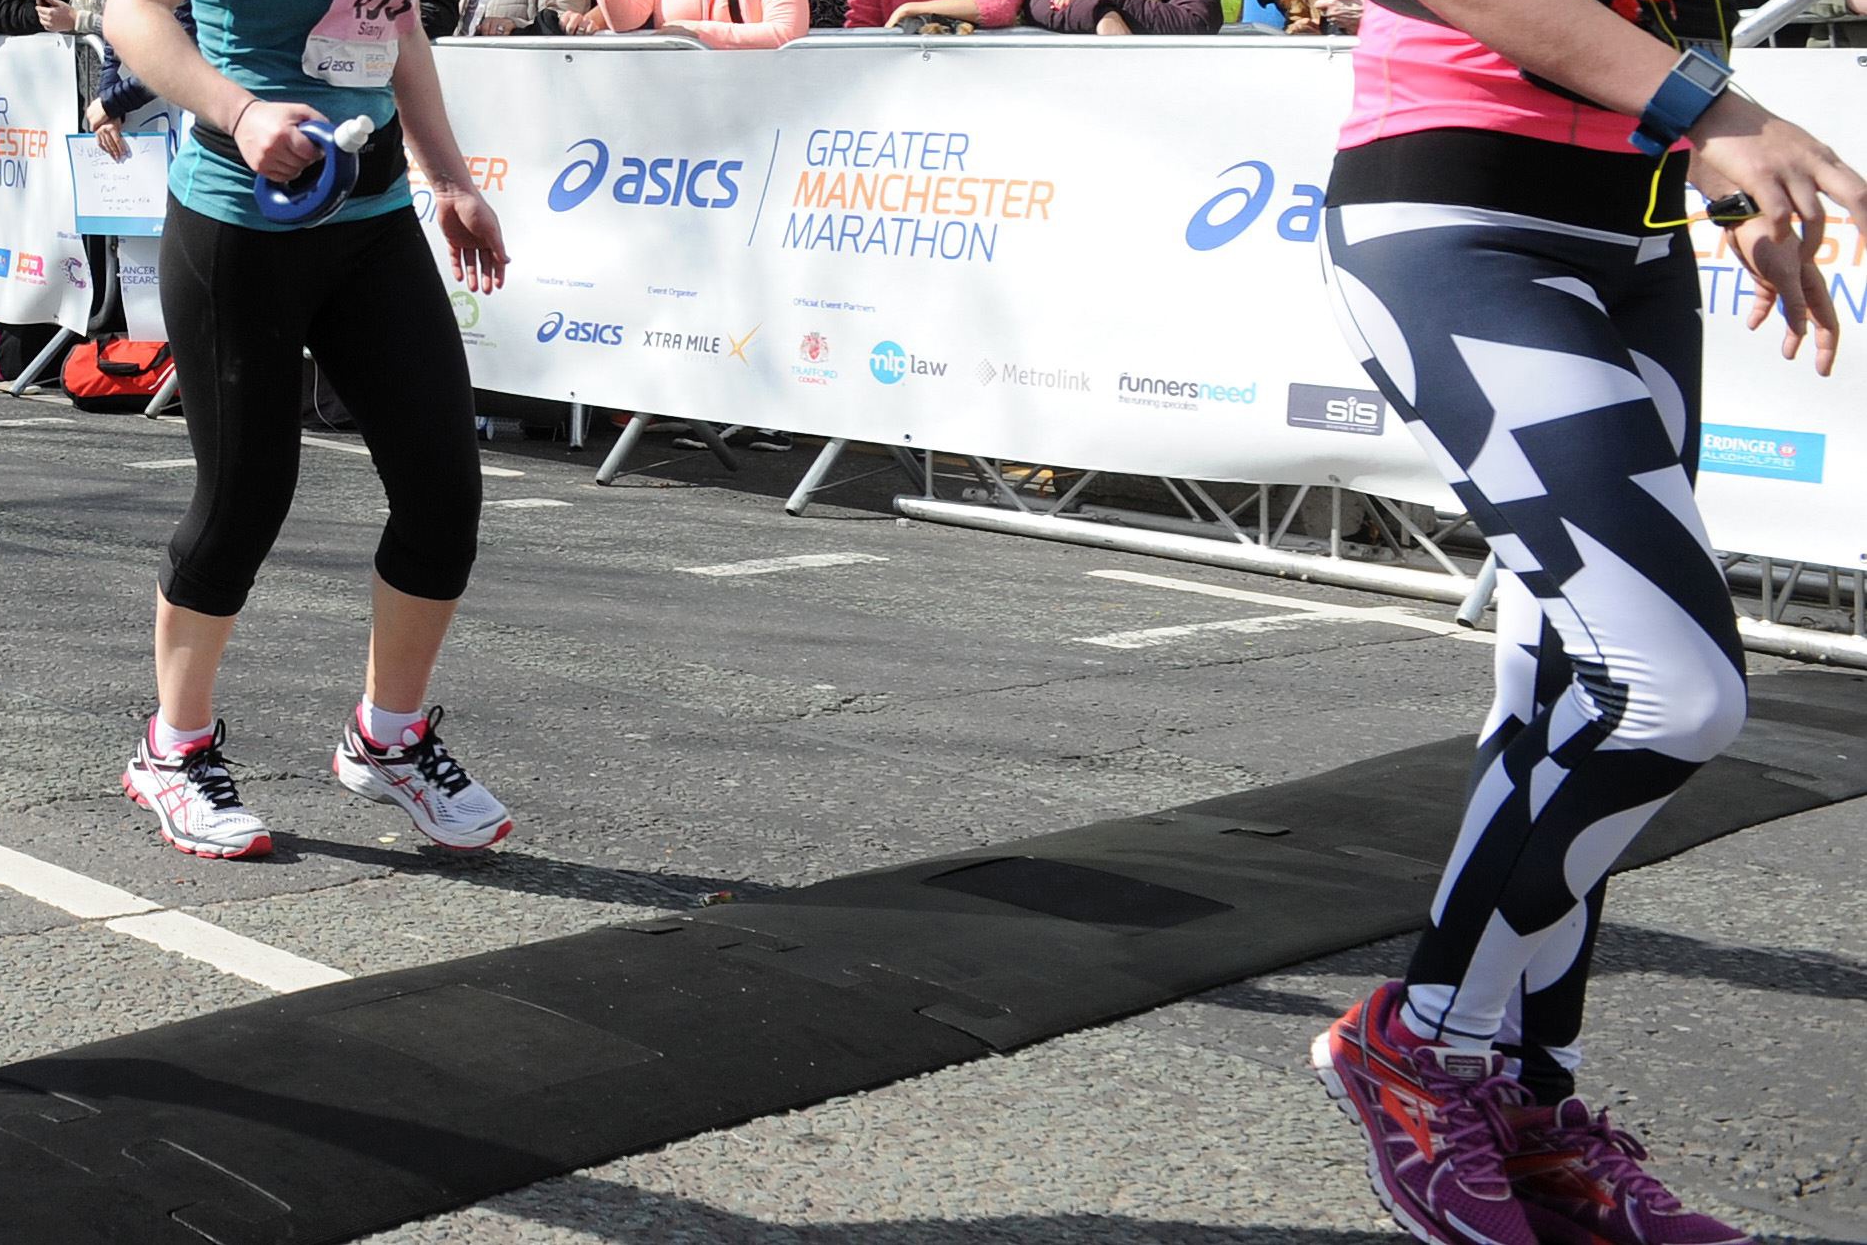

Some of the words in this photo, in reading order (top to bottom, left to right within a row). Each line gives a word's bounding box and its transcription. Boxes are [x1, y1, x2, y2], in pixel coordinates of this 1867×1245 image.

[332, 60, 355, 72] asics
[805, 129, 970, 172] GREATER
[612, 157, 743, 210] asics
[792, 171, 1055, 221] MANCHESTER
[782, 211, 998, 263] MARATHON
[122, 266, 156, 275] ANCER
[122, 276, 158, 285] ESEARC
[820, 299, 841, 309] Event
[565, 320, 624, 346] asics
[643, 330, 682, 350] XTRA
[686, 334, 721, 354] MILE
[791, 365, 837, 379] TRAFFORD
[1002, 363, 1091, 392] Metrolink
[1703, 434, 1777, 455] ERDINGER
